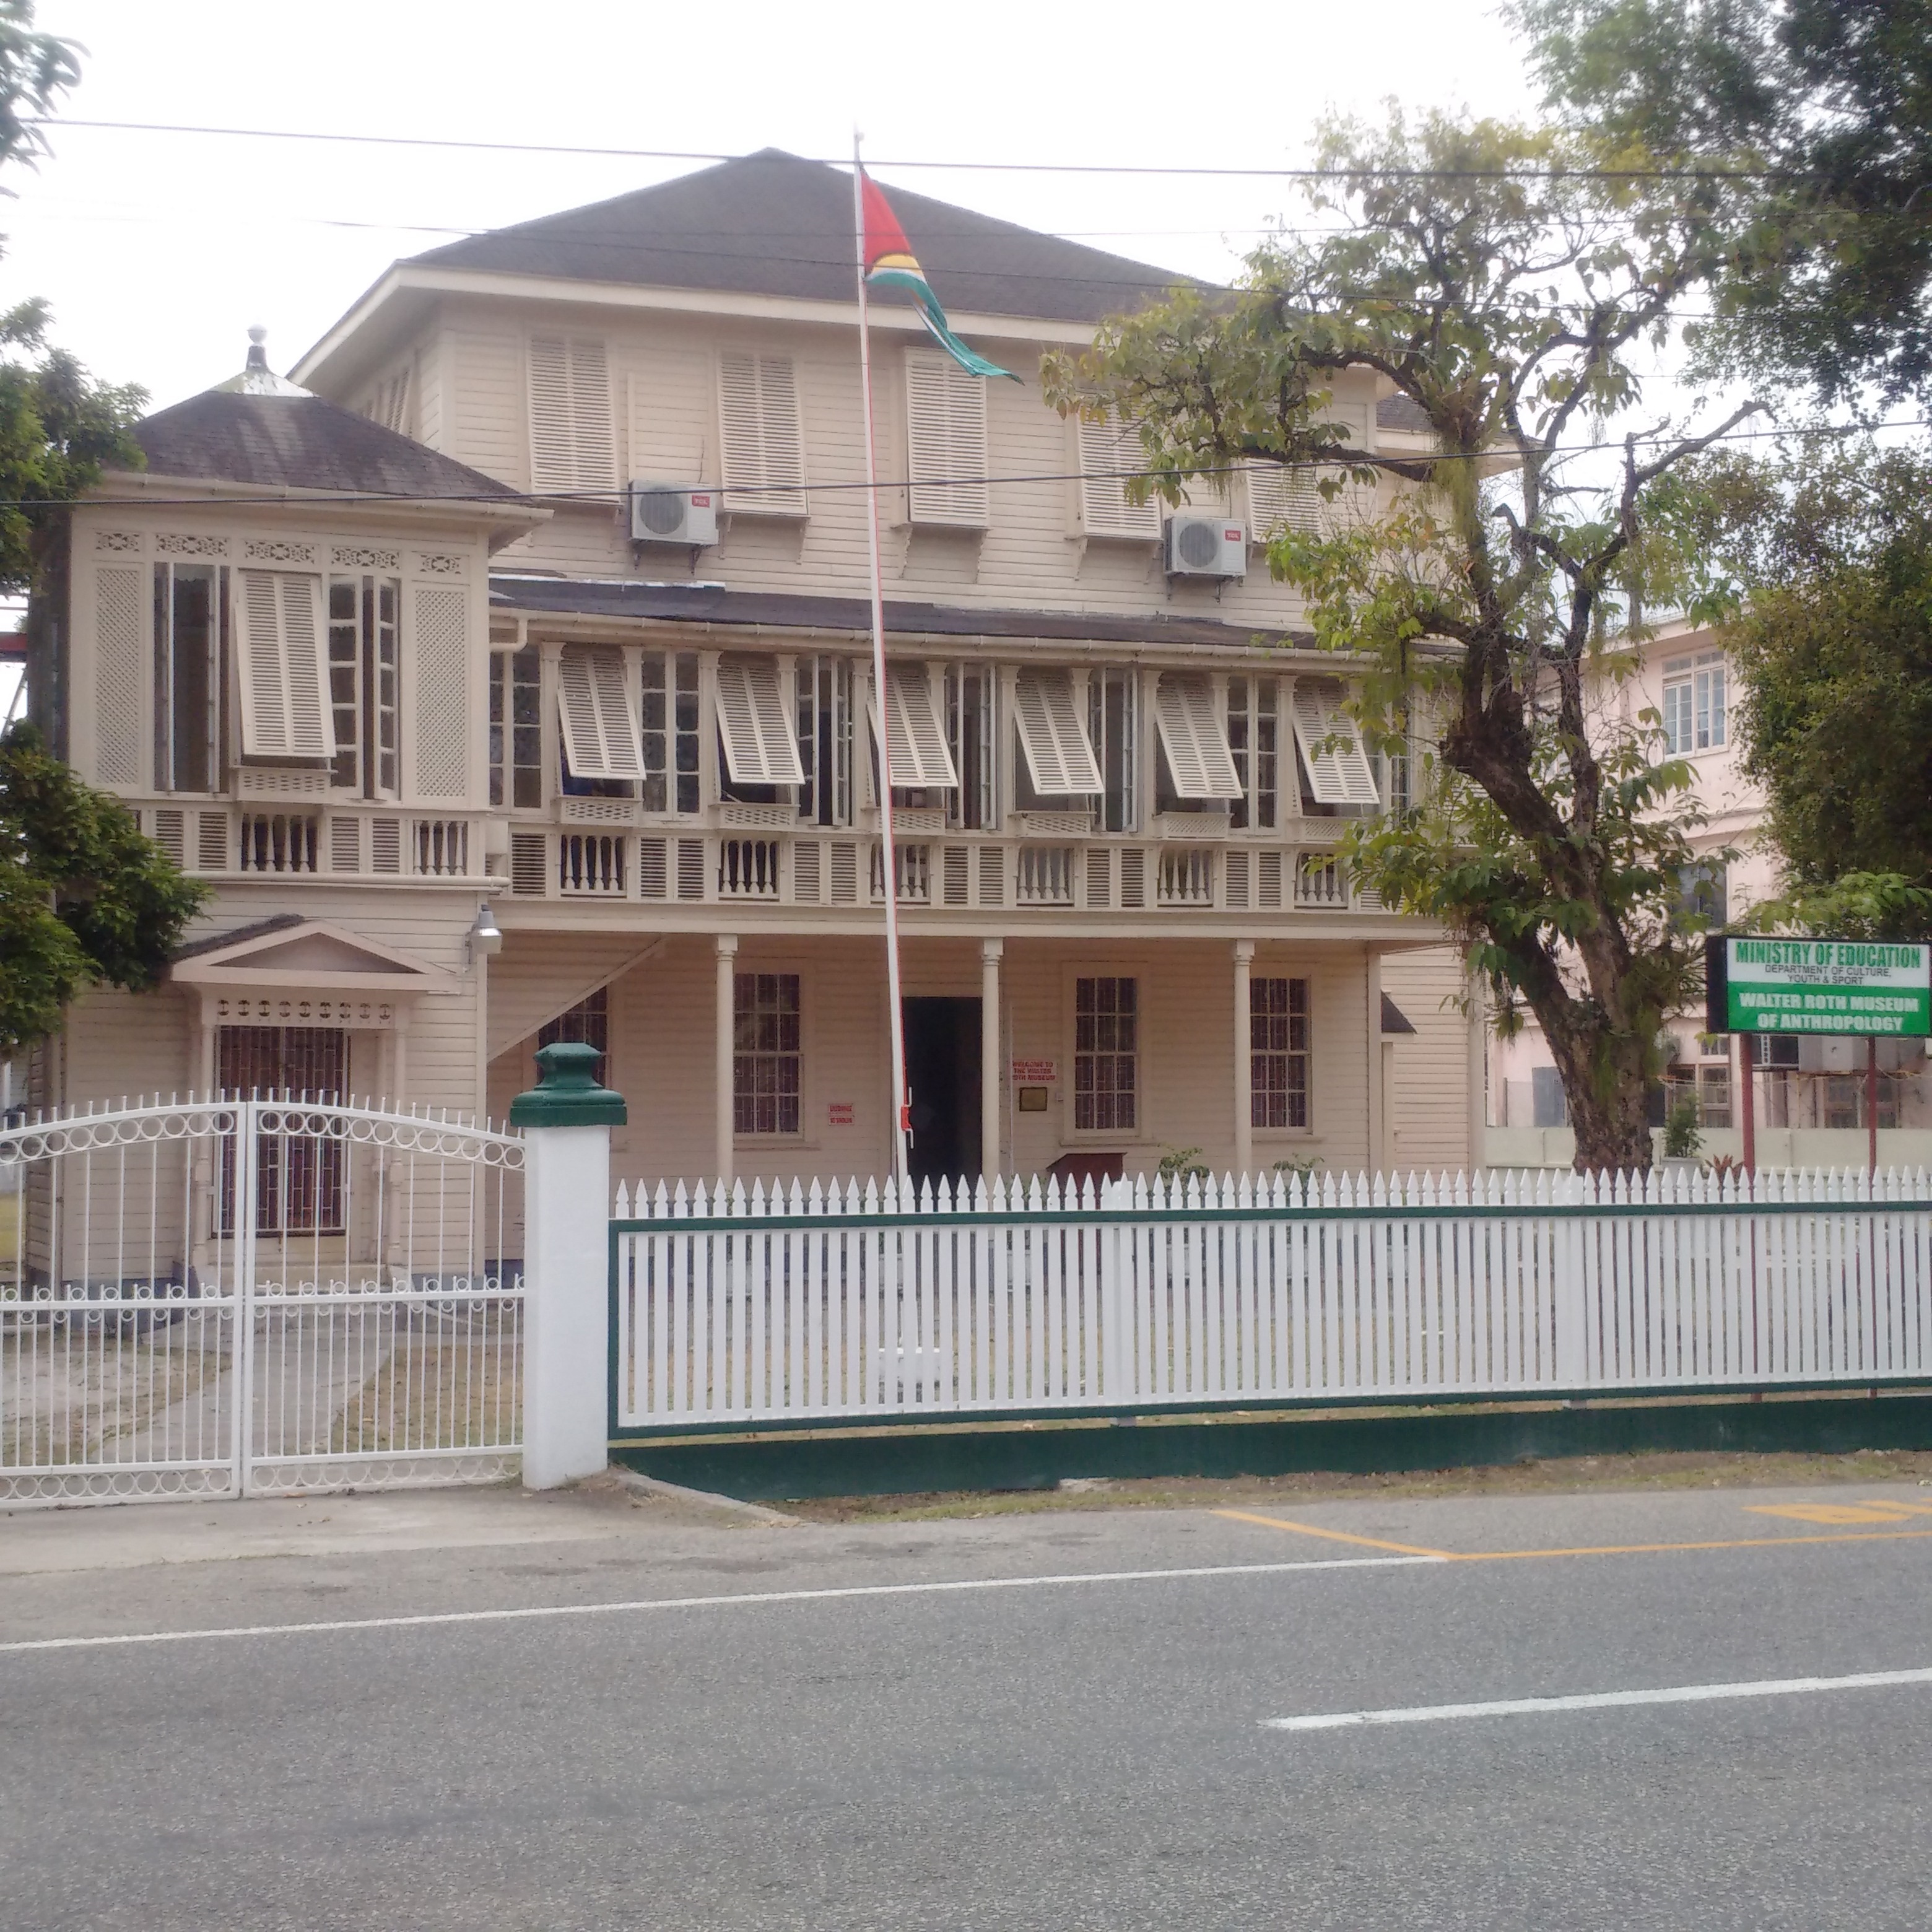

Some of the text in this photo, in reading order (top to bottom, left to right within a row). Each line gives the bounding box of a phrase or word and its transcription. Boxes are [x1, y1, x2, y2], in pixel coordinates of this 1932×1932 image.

[1736, 941, 1921, 968] MINISTRY OF EDUCATION
[1765, 964, 1828, 975] DEPARTMENT
[1831, 966, 1844, 975] OF
[1788, 974, 1863, 985] YOUTH & SPORT
[1739, 992, 1920, 1012] WALTER ROTH MUSEUM
[1757, 1013, 1904, 1031] OF ANTHROPOLOGY
